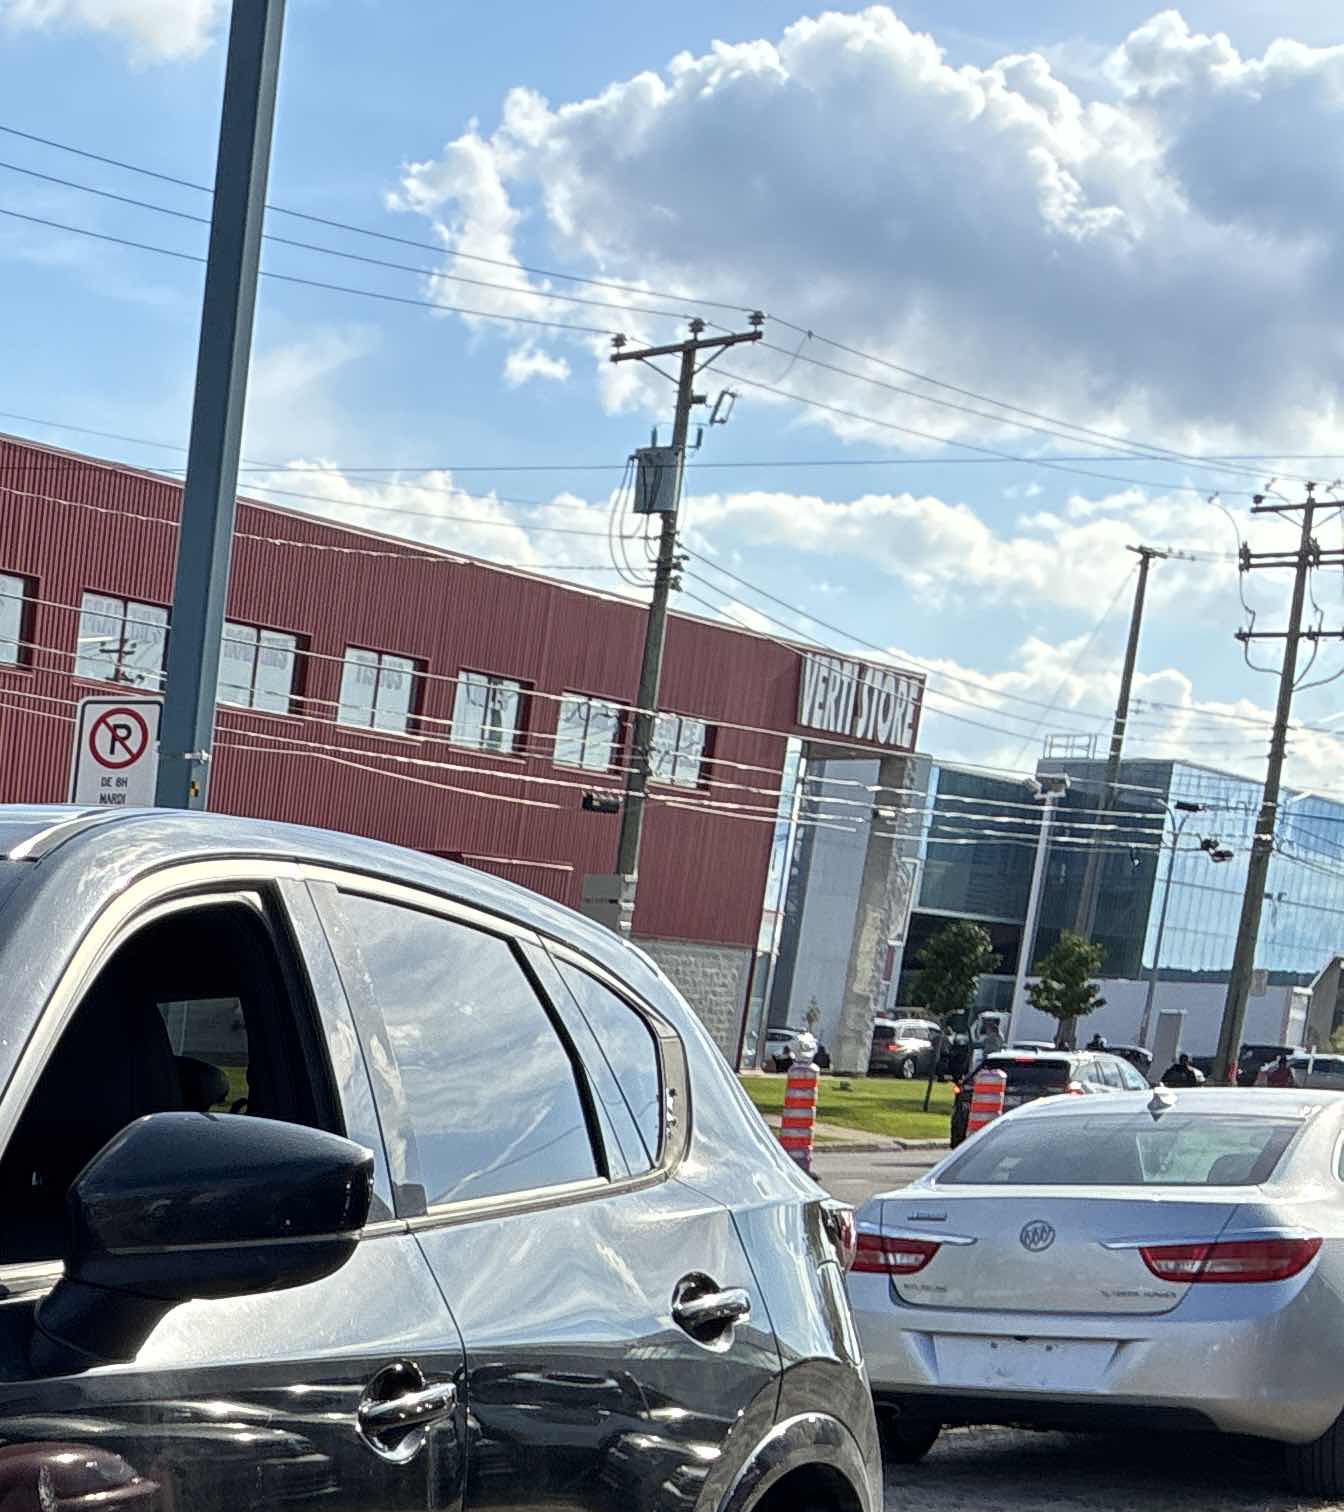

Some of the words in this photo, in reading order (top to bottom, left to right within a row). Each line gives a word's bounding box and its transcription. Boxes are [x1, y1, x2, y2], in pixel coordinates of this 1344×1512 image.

[800, 652, 859, 736] VERTI
[855, 665, 921, 749] STORE
[100, 776, 113, 788] DE
[98, 792, 127, 805] MARDI
